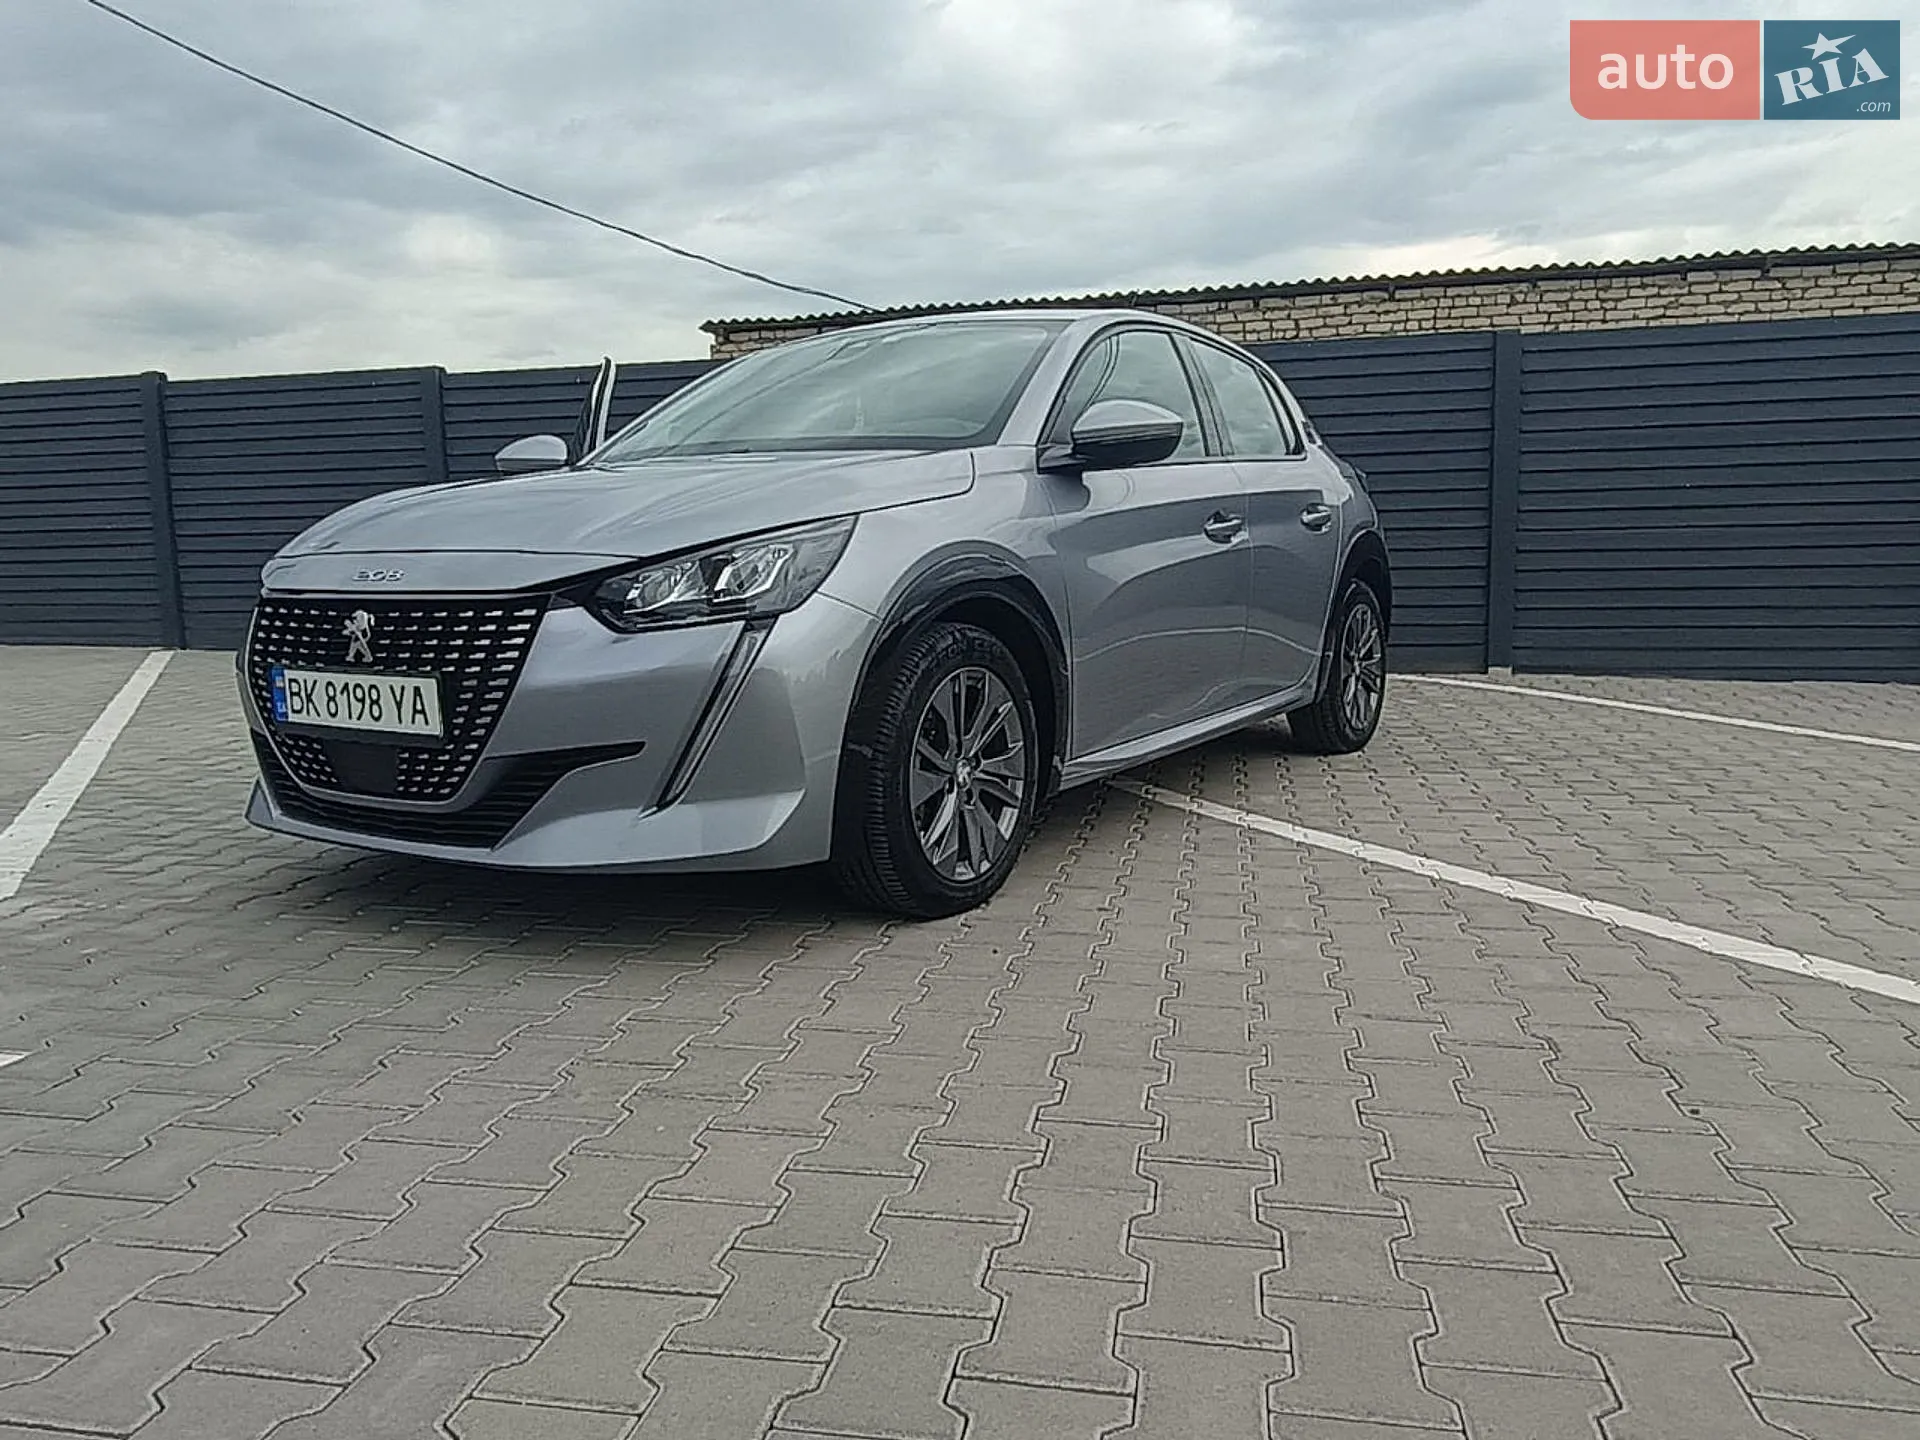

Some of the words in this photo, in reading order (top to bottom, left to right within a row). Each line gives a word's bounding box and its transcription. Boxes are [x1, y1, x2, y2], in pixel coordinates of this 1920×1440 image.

[288, 678, 321, 717] BK
[325, 681, 382, 722] 8198
[389, 684, 429, 726] YA
